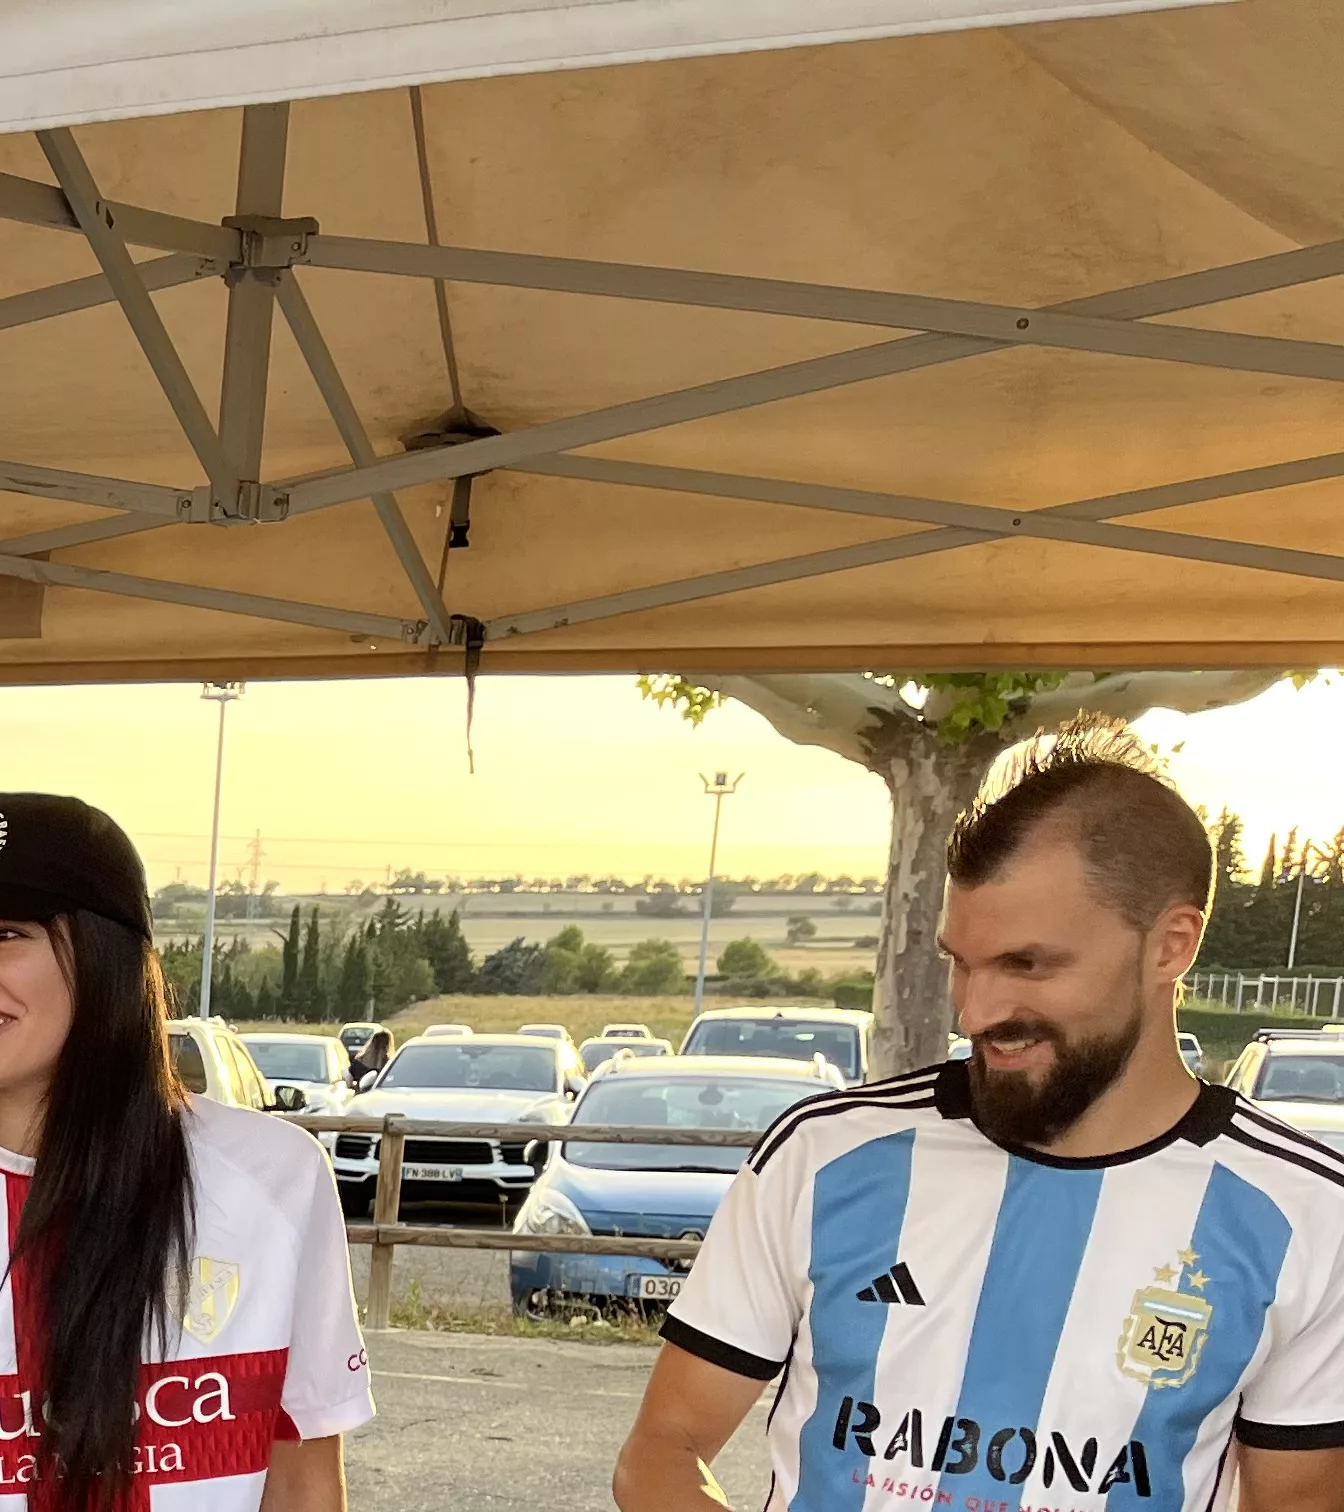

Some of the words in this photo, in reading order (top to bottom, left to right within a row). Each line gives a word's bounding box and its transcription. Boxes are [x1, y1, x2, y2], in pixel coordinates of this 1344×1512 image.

[1137, 1315, 1187, 1362] AFA
[832, 1396, 1151, 1497] RABONA
[852, 1469, 877, 1488] LA
[881, 1477, 953, 1505] PASIÓN
